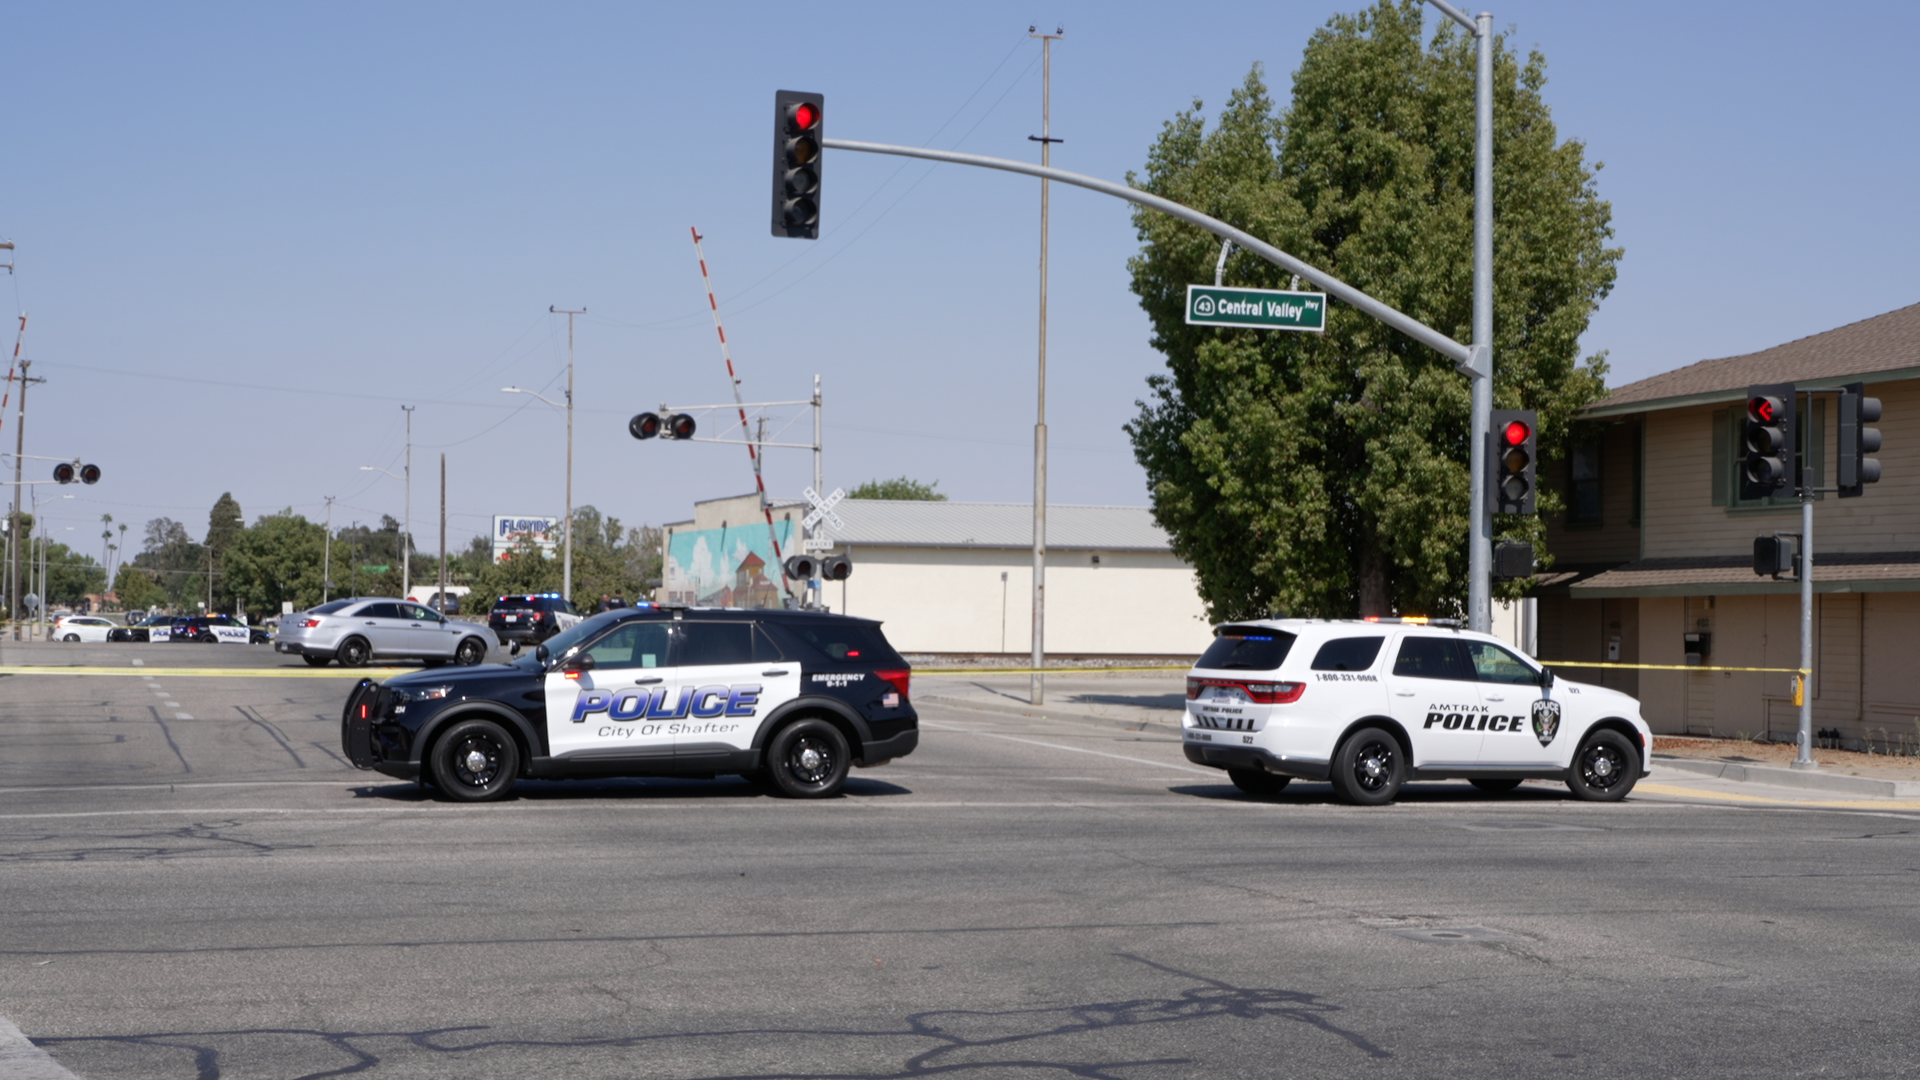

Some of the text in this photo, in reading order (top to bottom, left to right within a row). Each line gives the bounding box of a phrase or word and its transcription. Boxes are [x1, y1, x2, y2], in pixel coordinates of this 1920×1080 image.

[1198, 298, 1319, 322] 43 Central Valley Hwy
[811, 673, 866, 682] EMERGENCY
[570, 684, 763, 723] POLICE
[1221, 707, 1243, 715] POLICE
[1429, 703, 1489, 713] AMTRAK
[1533, 701, 1559, 716] POLICE
[598, 722, 740, 738] City Of Shafter
[1423, 712, 1525, 733] POLICE
[1242, 735, 1254, 745] 522
